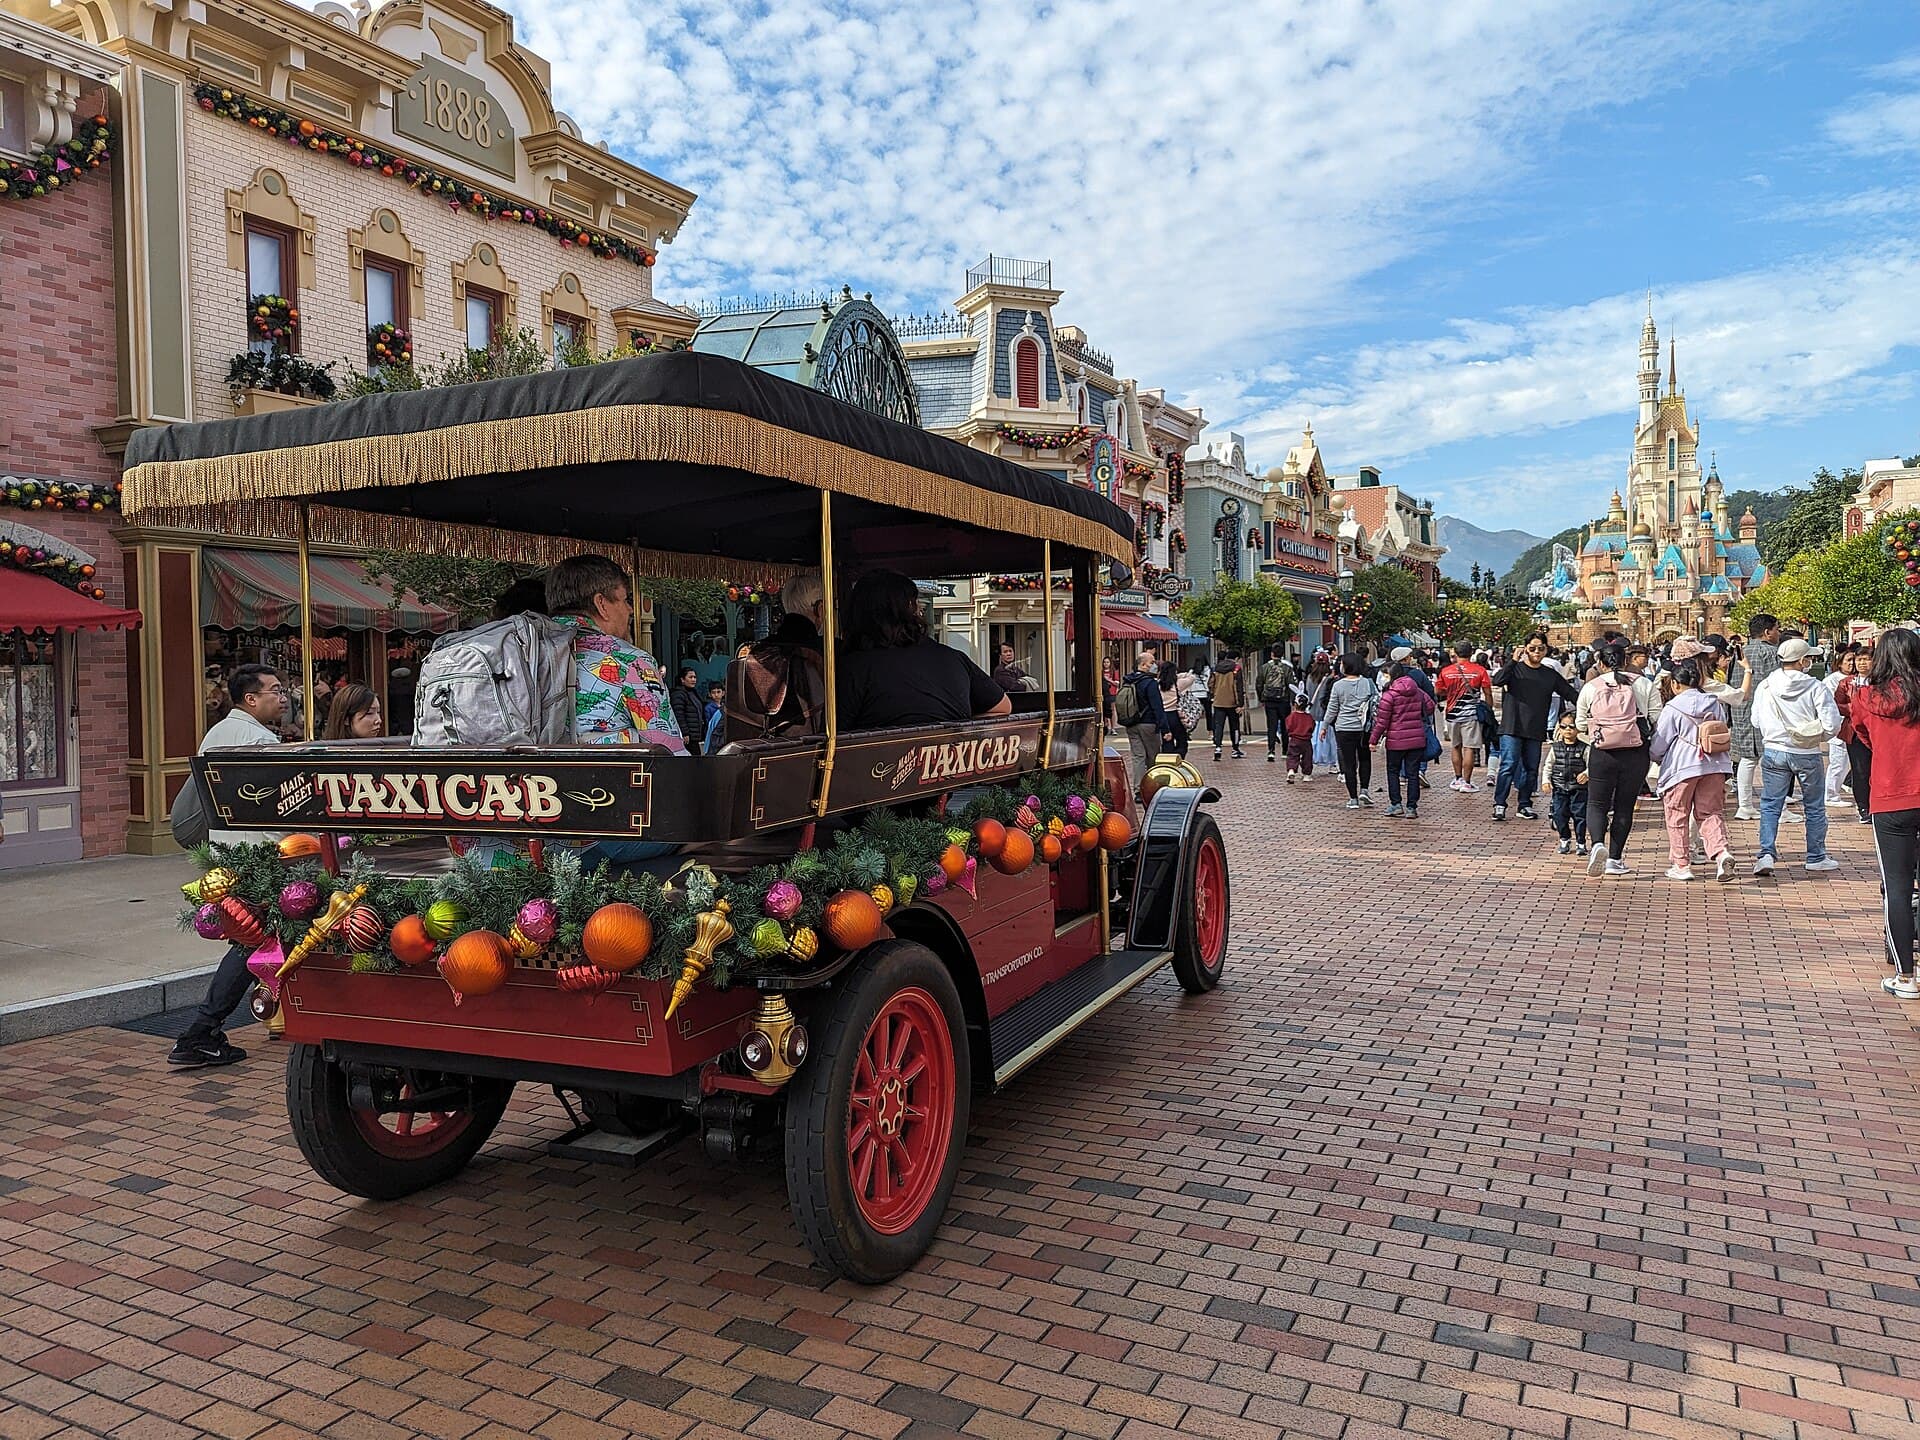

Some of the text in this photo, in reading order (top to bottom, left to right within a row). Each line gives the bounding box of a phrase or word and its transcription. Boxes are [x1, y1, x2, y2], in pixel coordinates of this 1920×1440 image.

[418, 74, 492, 148] 1888
[1154, 580, 1189, 593] CURIOSITY
[891, 755, 918, 789] STREET
[896, 746, 916, 772] MAIN
[919, 735, 1021, 783] TAXICAB
[277, 781, 313, 816] STREET
[280, 771, 305, 795] MAIN
[315, 773, 563, 821] TAXICAB
[985, 950, 1034, 985] TRANSPORTATION
